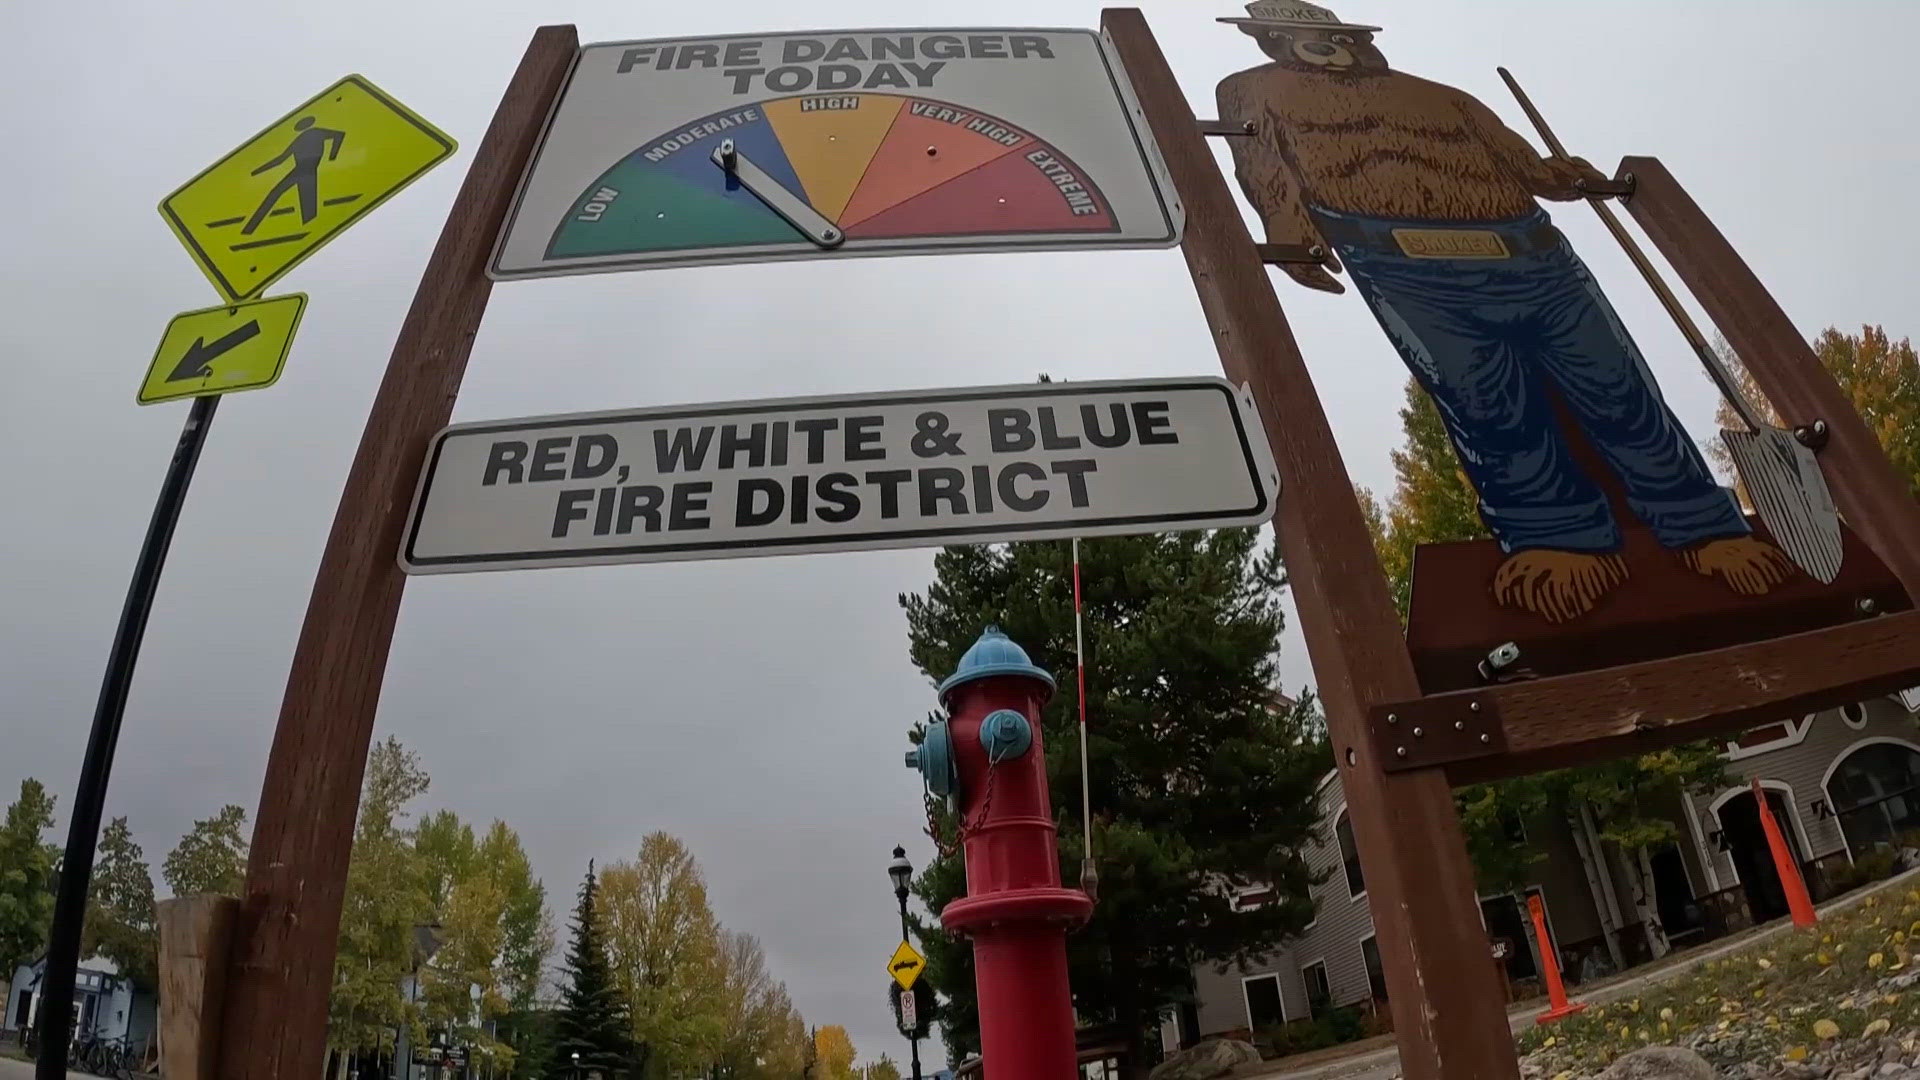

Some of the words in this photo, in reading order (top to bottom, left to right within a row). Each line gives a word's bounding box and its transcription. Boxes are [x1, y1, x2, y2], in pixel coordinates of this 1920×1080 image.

[1251, 7, 1331, 22] SMOKEY
[616, 41, 763, 74] FIRE
[782, 35, 1055, 63] DANGER
[723, 61, 947, 94] TODAY
[801, 97, 858, 111] HIGH
[911, 102, 966, 124] VERY
[966, 116, 1022, 147] HIGH
[644, 108, 759, 162] MODERATE
[1027, 149, 1099, 216] EXTREME
[578, 186, 620, 222] LOW
[482, 433, 630, 486] RED,
[653, 416, 886, 474] WHITE
[911, 411, 967, 458] &
[988, 401, 1179, 453] BLUE
[551, 481, 713, 538] FIRE
[735, 459, 1098, 528] DISTRICT
